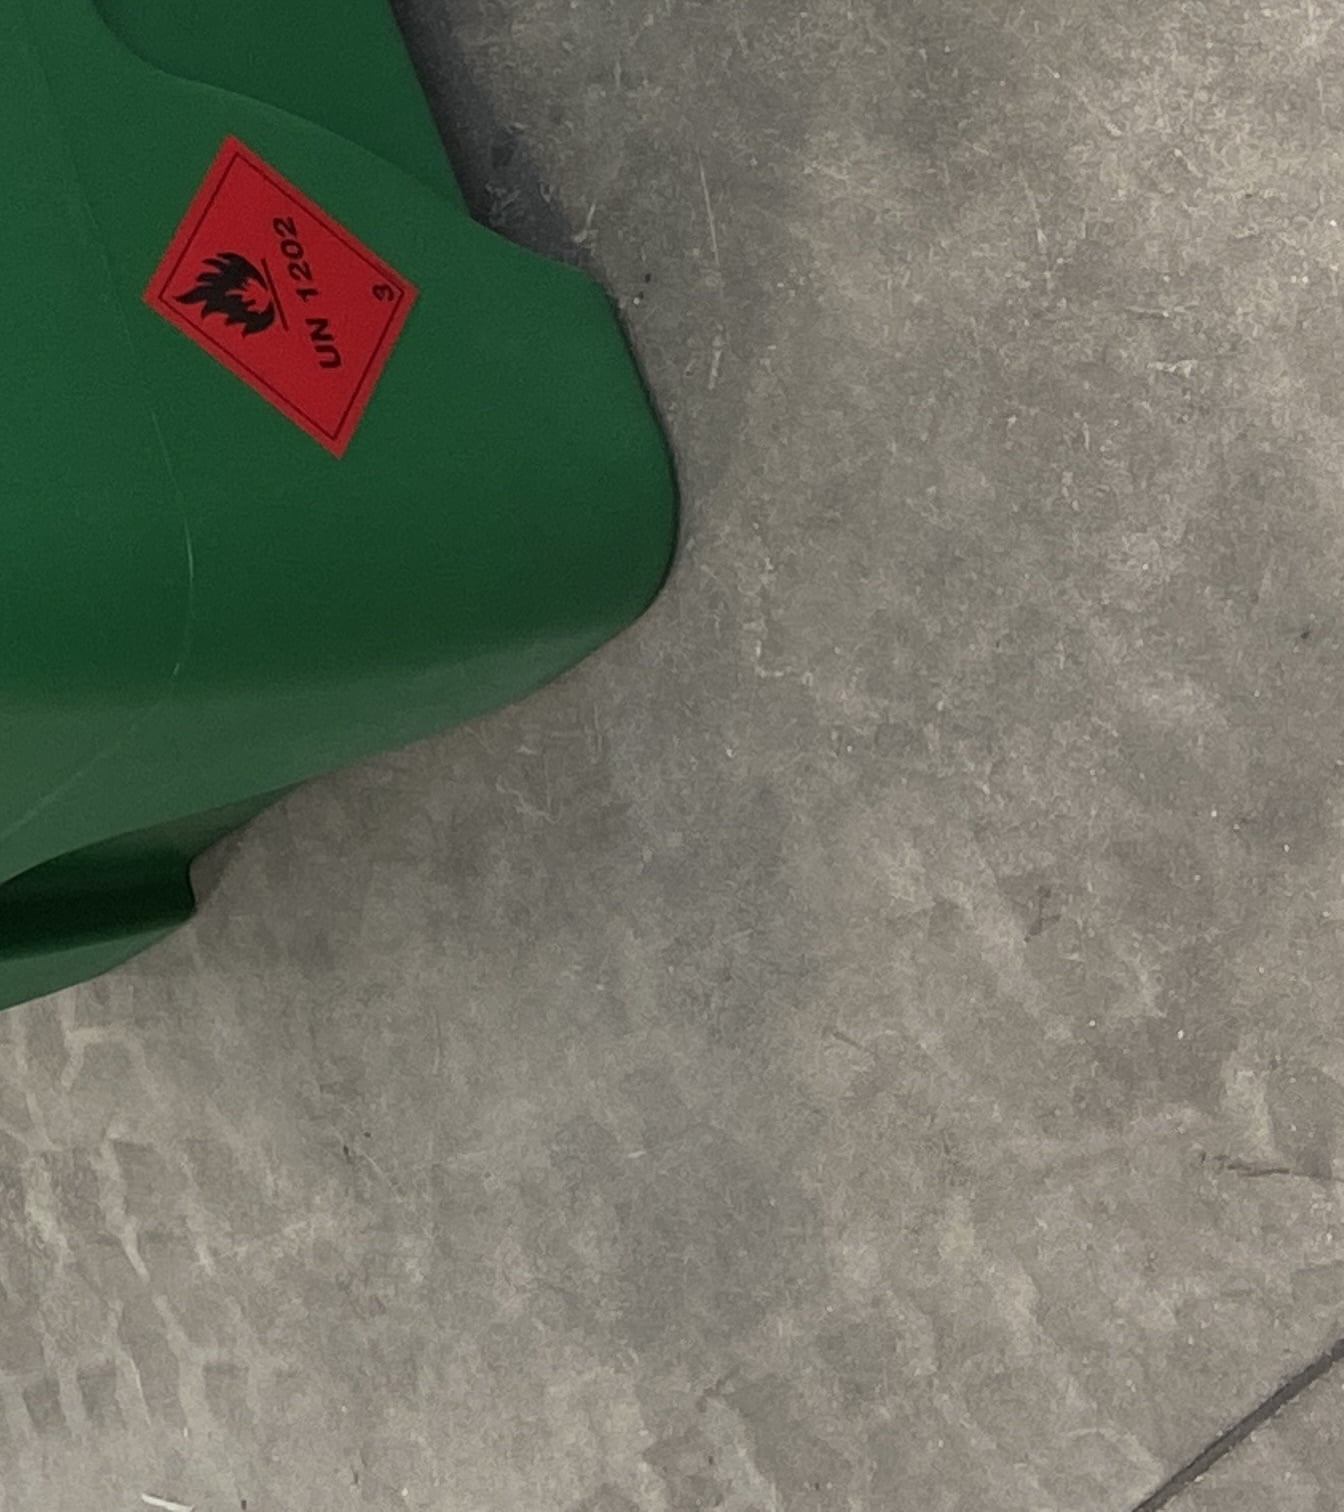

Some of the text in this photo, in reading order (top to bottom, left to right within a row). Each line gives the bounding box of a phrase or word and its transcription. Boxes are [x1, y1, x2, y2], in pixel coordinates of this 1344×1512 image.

[272, 216, 342, 369] UN 1202
[372, 284, 394, 302] 3
